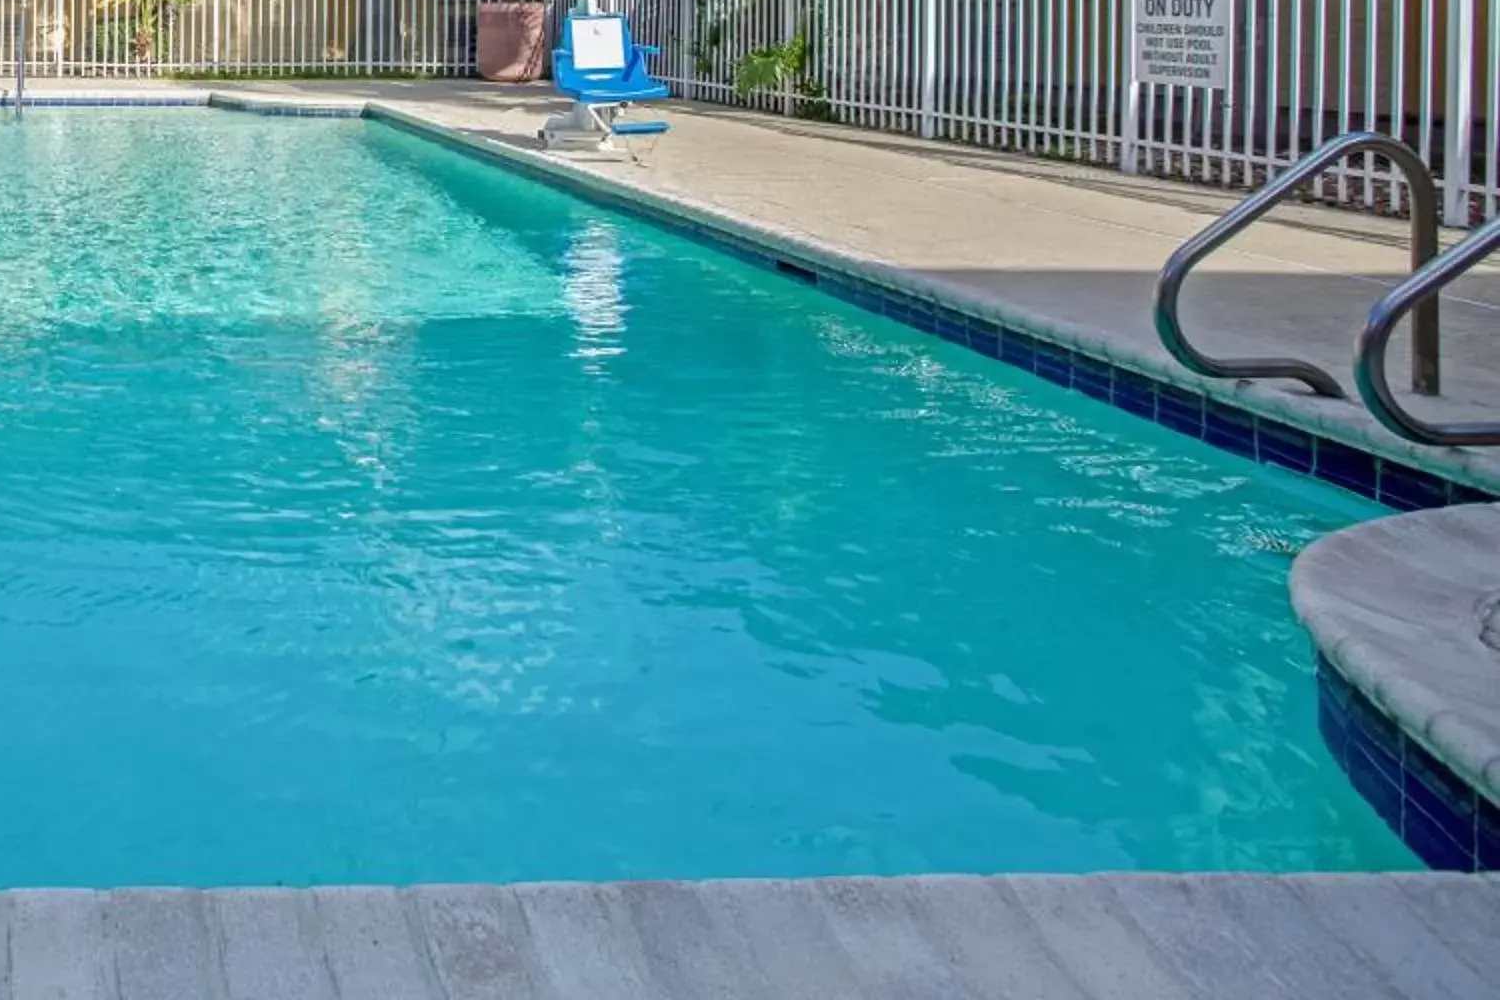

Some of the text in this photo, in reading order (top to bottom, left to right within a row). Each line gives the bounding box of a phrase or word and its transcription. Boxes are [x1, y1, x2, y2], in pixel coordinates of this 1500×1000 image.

[1137, 23, 1224, 37] CHILDREN SHOULD
[1166, 38, 1184, 49] USE
[1187, 39, 1213, 50] POOL
[1186, 53, 1218, 65] ADULT
[1148, 65, 1210, 78] SUPERVISION
